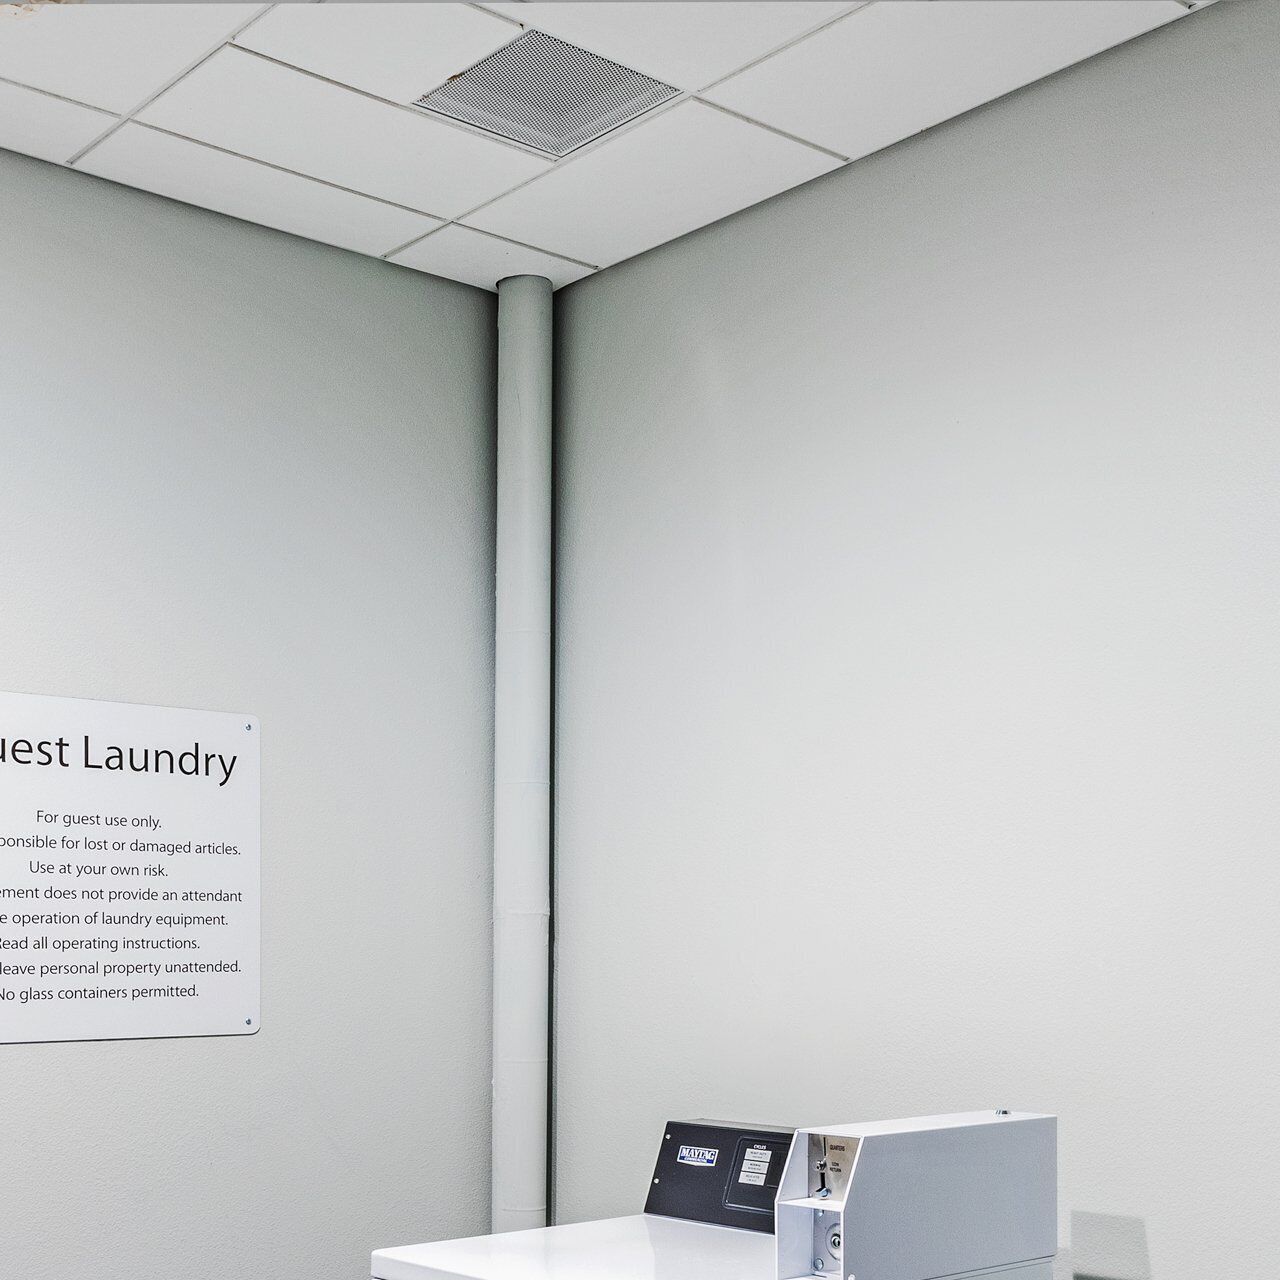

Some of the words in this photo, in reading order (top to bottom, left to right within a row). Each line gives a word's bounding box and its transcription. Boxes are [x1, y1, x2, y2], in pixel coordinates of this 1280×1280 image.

[83, 735, 238, 788] Laundry
[36, 809, 59, 824] For
[62, 814, 101, 828] guest
[104, 816, 128, 827] use
[131, 814, 162, 831] only.
[60, 835, 81, 850] for
[84, 836, 109, 851] lost
[111, 841, 127, 851] or
[129, 838, 192, 857] damaged
[194, 842, 241, 856] articles.
[29, 860, 55, 874] Use
[58, 863, 72, 875] at
[75, 864, 107, 878] your
[110, 865, 140, 876] own
[143, 863, 169, 877] risk.
[43, 885, 78, 900] does
[81, 888, 105, 900] not
[108, 887, 159, 903] provide
[161, 891, 178, 901] an
[181, 889, 243, 903] attendant
[11, 911, 80, 928] operation
[83, 911, 99, 925] of
[101, 911, 153, 928] laundry
[155, 912, 229, 929] equipment.
[32, 936, 48, 950] all
[52, 936, 119, 953] operating
[122, 936, 201, 950] instructions.
[0, 961, 36, 976] leave
[40, 960, 99, 978] personal
[103, 962, 162, 978] property
[164, 959, 242, 974] unattended.
[19, 986, 54, 1004] glass
[57, 986, 128, 1000] containers
[131, 983, 199, 1001] permitted.
[680, 1148, 716, 1160] MAYTAG
